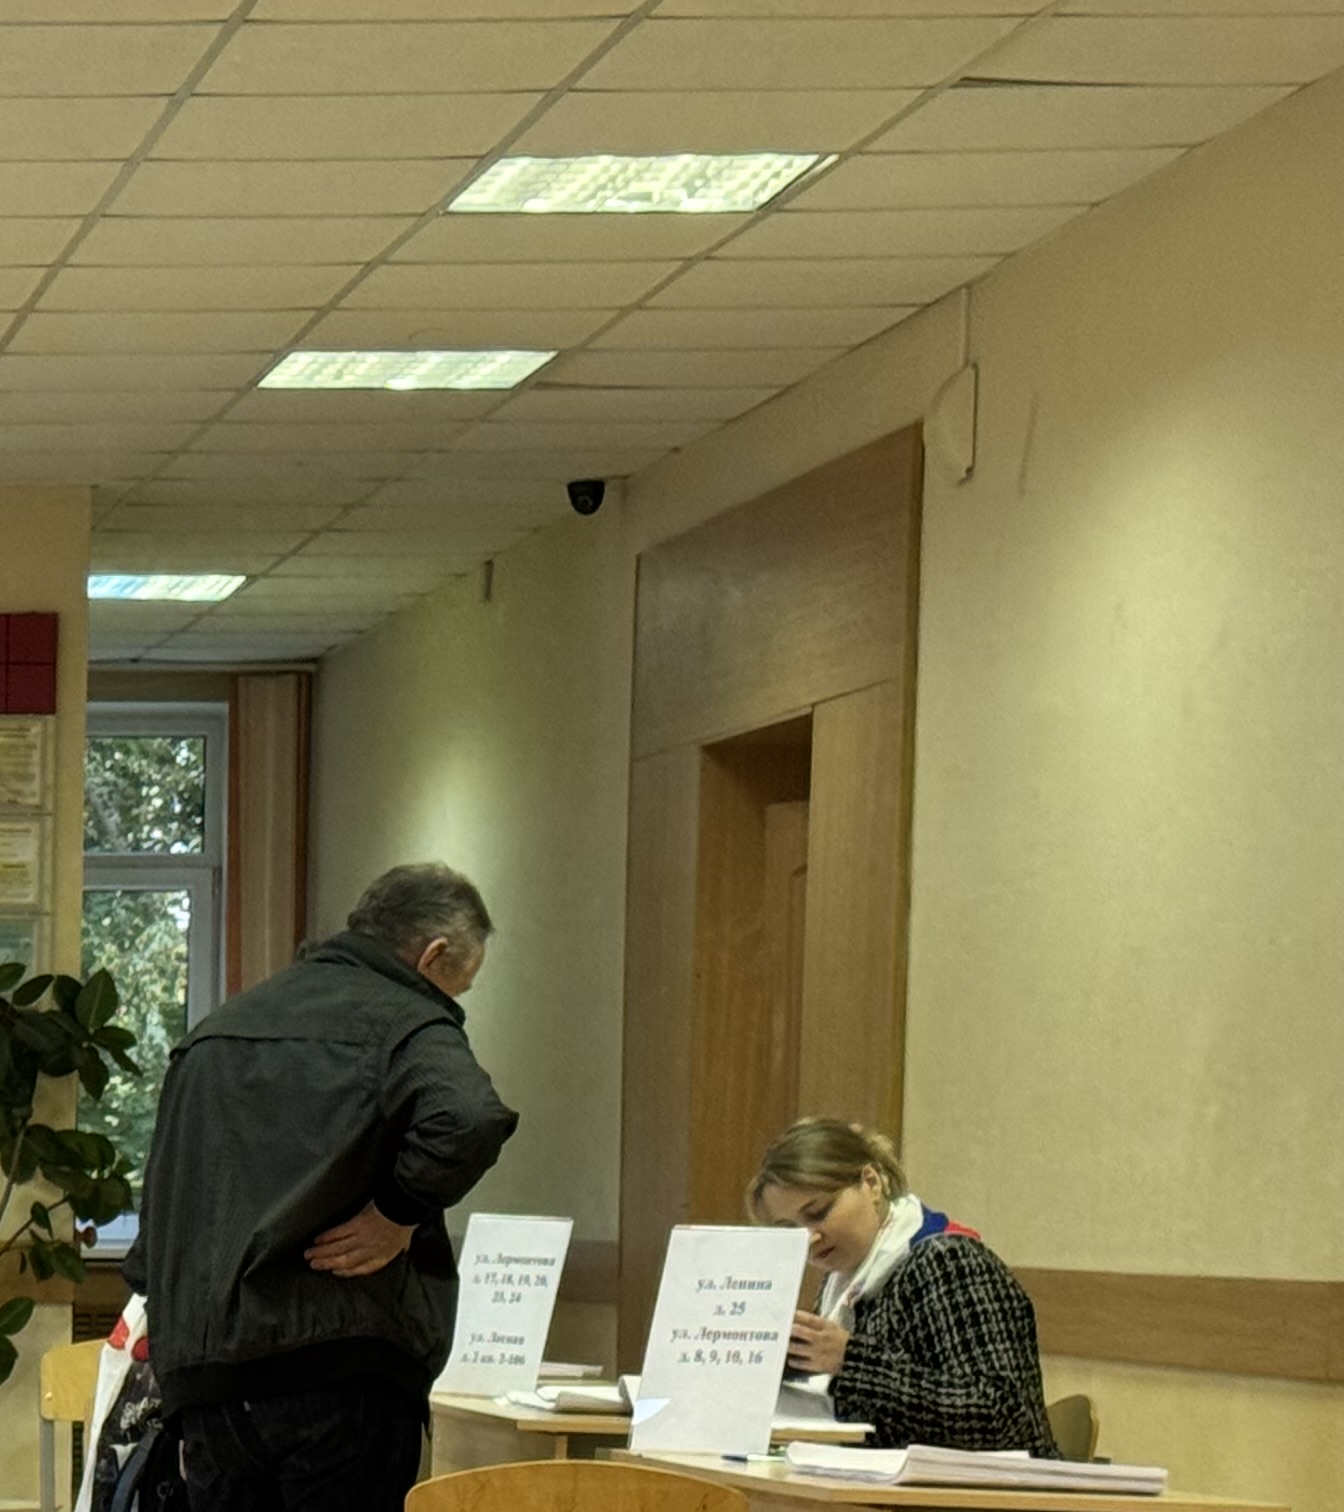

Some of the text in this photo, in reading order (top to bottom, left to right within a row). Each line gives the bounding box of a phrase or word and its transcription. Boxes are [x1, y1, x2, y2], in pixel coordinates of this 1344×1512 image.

[696, 1275, 773, 1293] ул. Ленина
[670, 1326, 779, 1344] ул. Лермонтова
